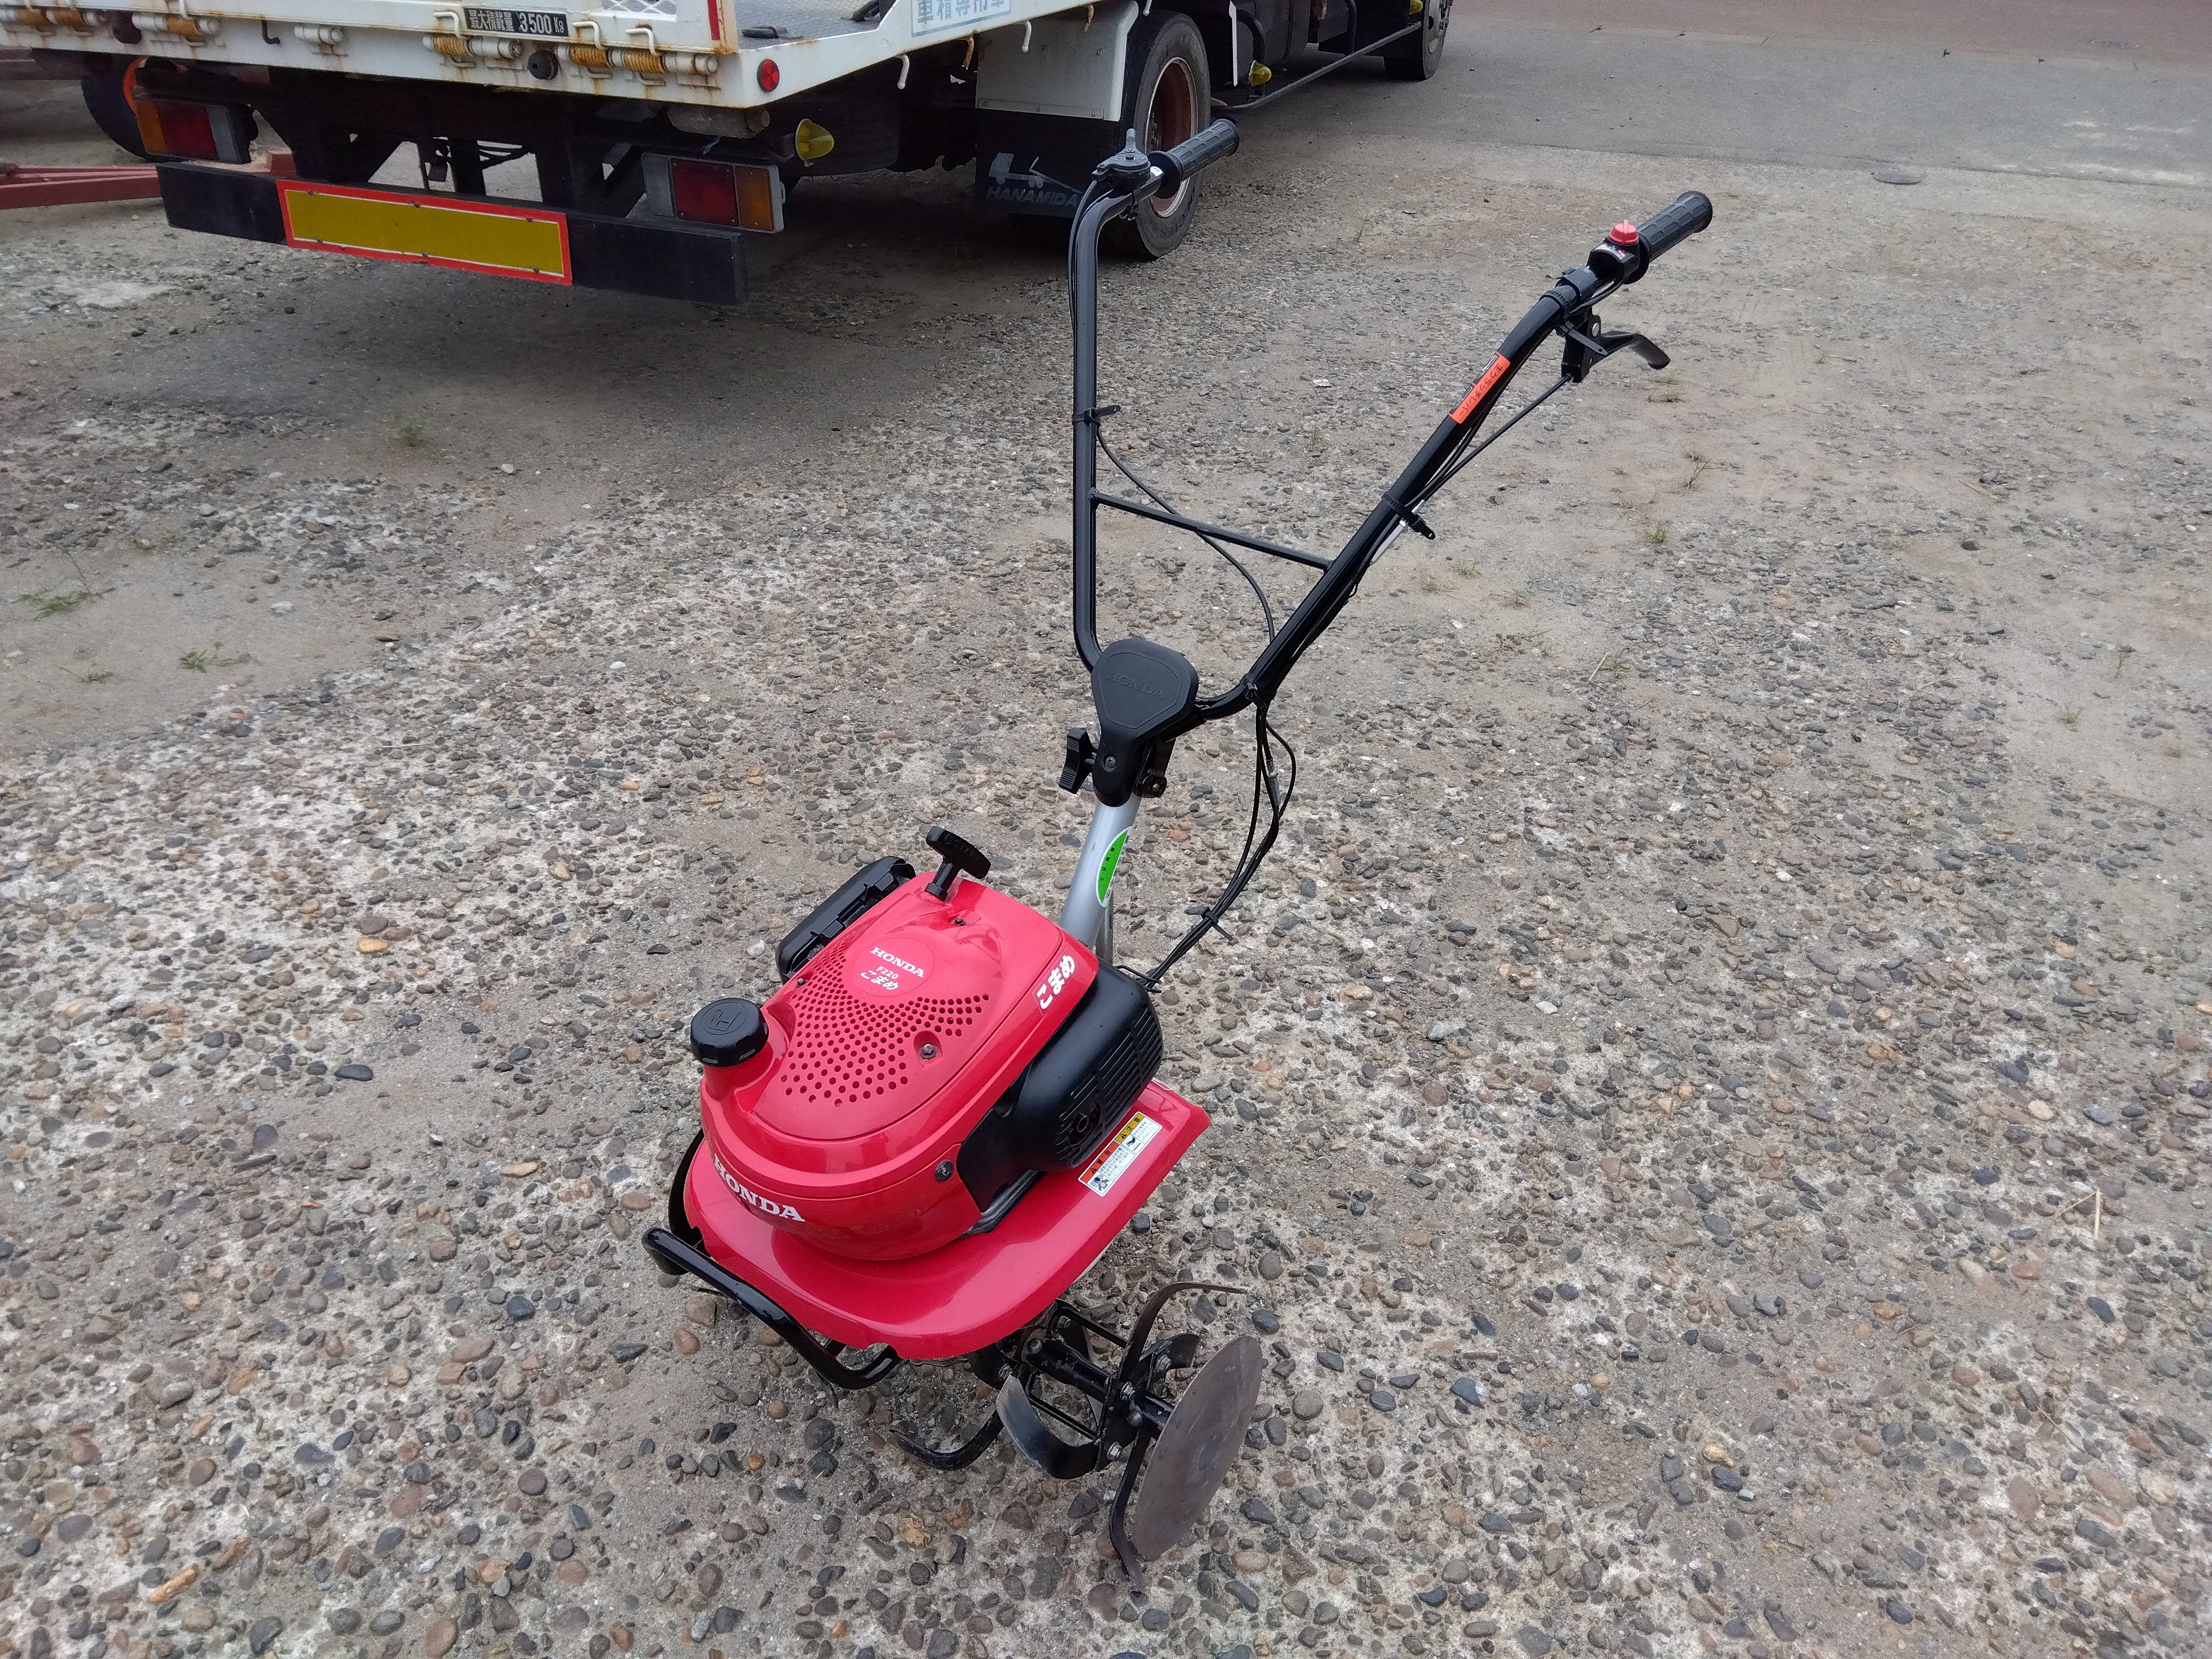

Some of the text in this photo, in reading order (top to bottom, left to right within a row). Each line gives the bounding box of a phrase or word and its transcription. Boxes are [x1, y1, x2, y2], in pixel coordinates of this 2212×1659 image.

[469, 10, 514, 32] 最大積載量
[518, 12, 552, 34] 3500
[1106, 672, 1166, 700] HONDA
[870, 946, 924, 978] HONDA
[876, 966, 899, 979] F220
[860, 970, 899, 990] こまめ
[1036, 954, 1075, 1009] こまめ
[1126, 1116, 1141, 1132] 注意
[714, 1153, 806, 1222] HONDA
